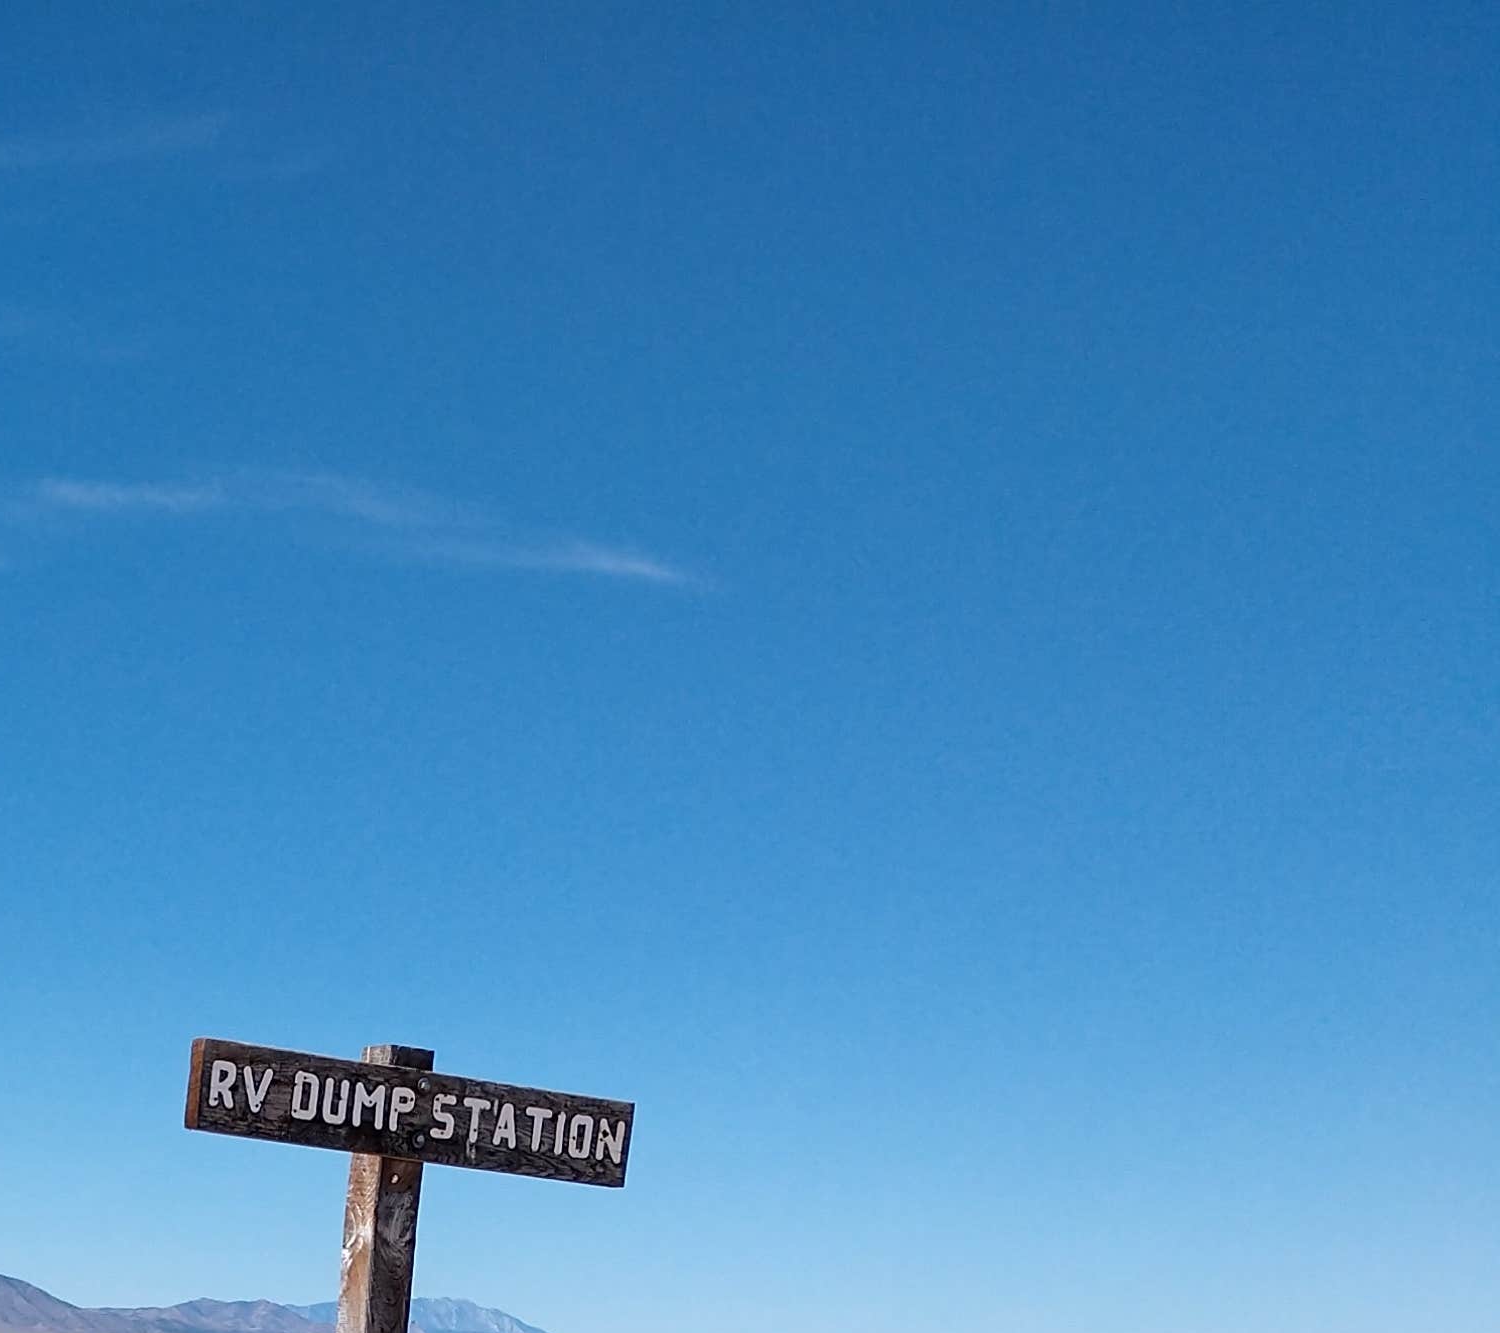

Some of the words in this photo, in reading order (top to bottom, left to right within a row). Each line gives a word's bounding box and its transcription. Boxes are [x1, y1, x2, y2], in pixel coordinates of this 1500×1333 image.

[209, 1060, 273, 1114] RV
[291, 1071, 416, 1132] DUMP
[429, 1093, 626, 1165] STATION
